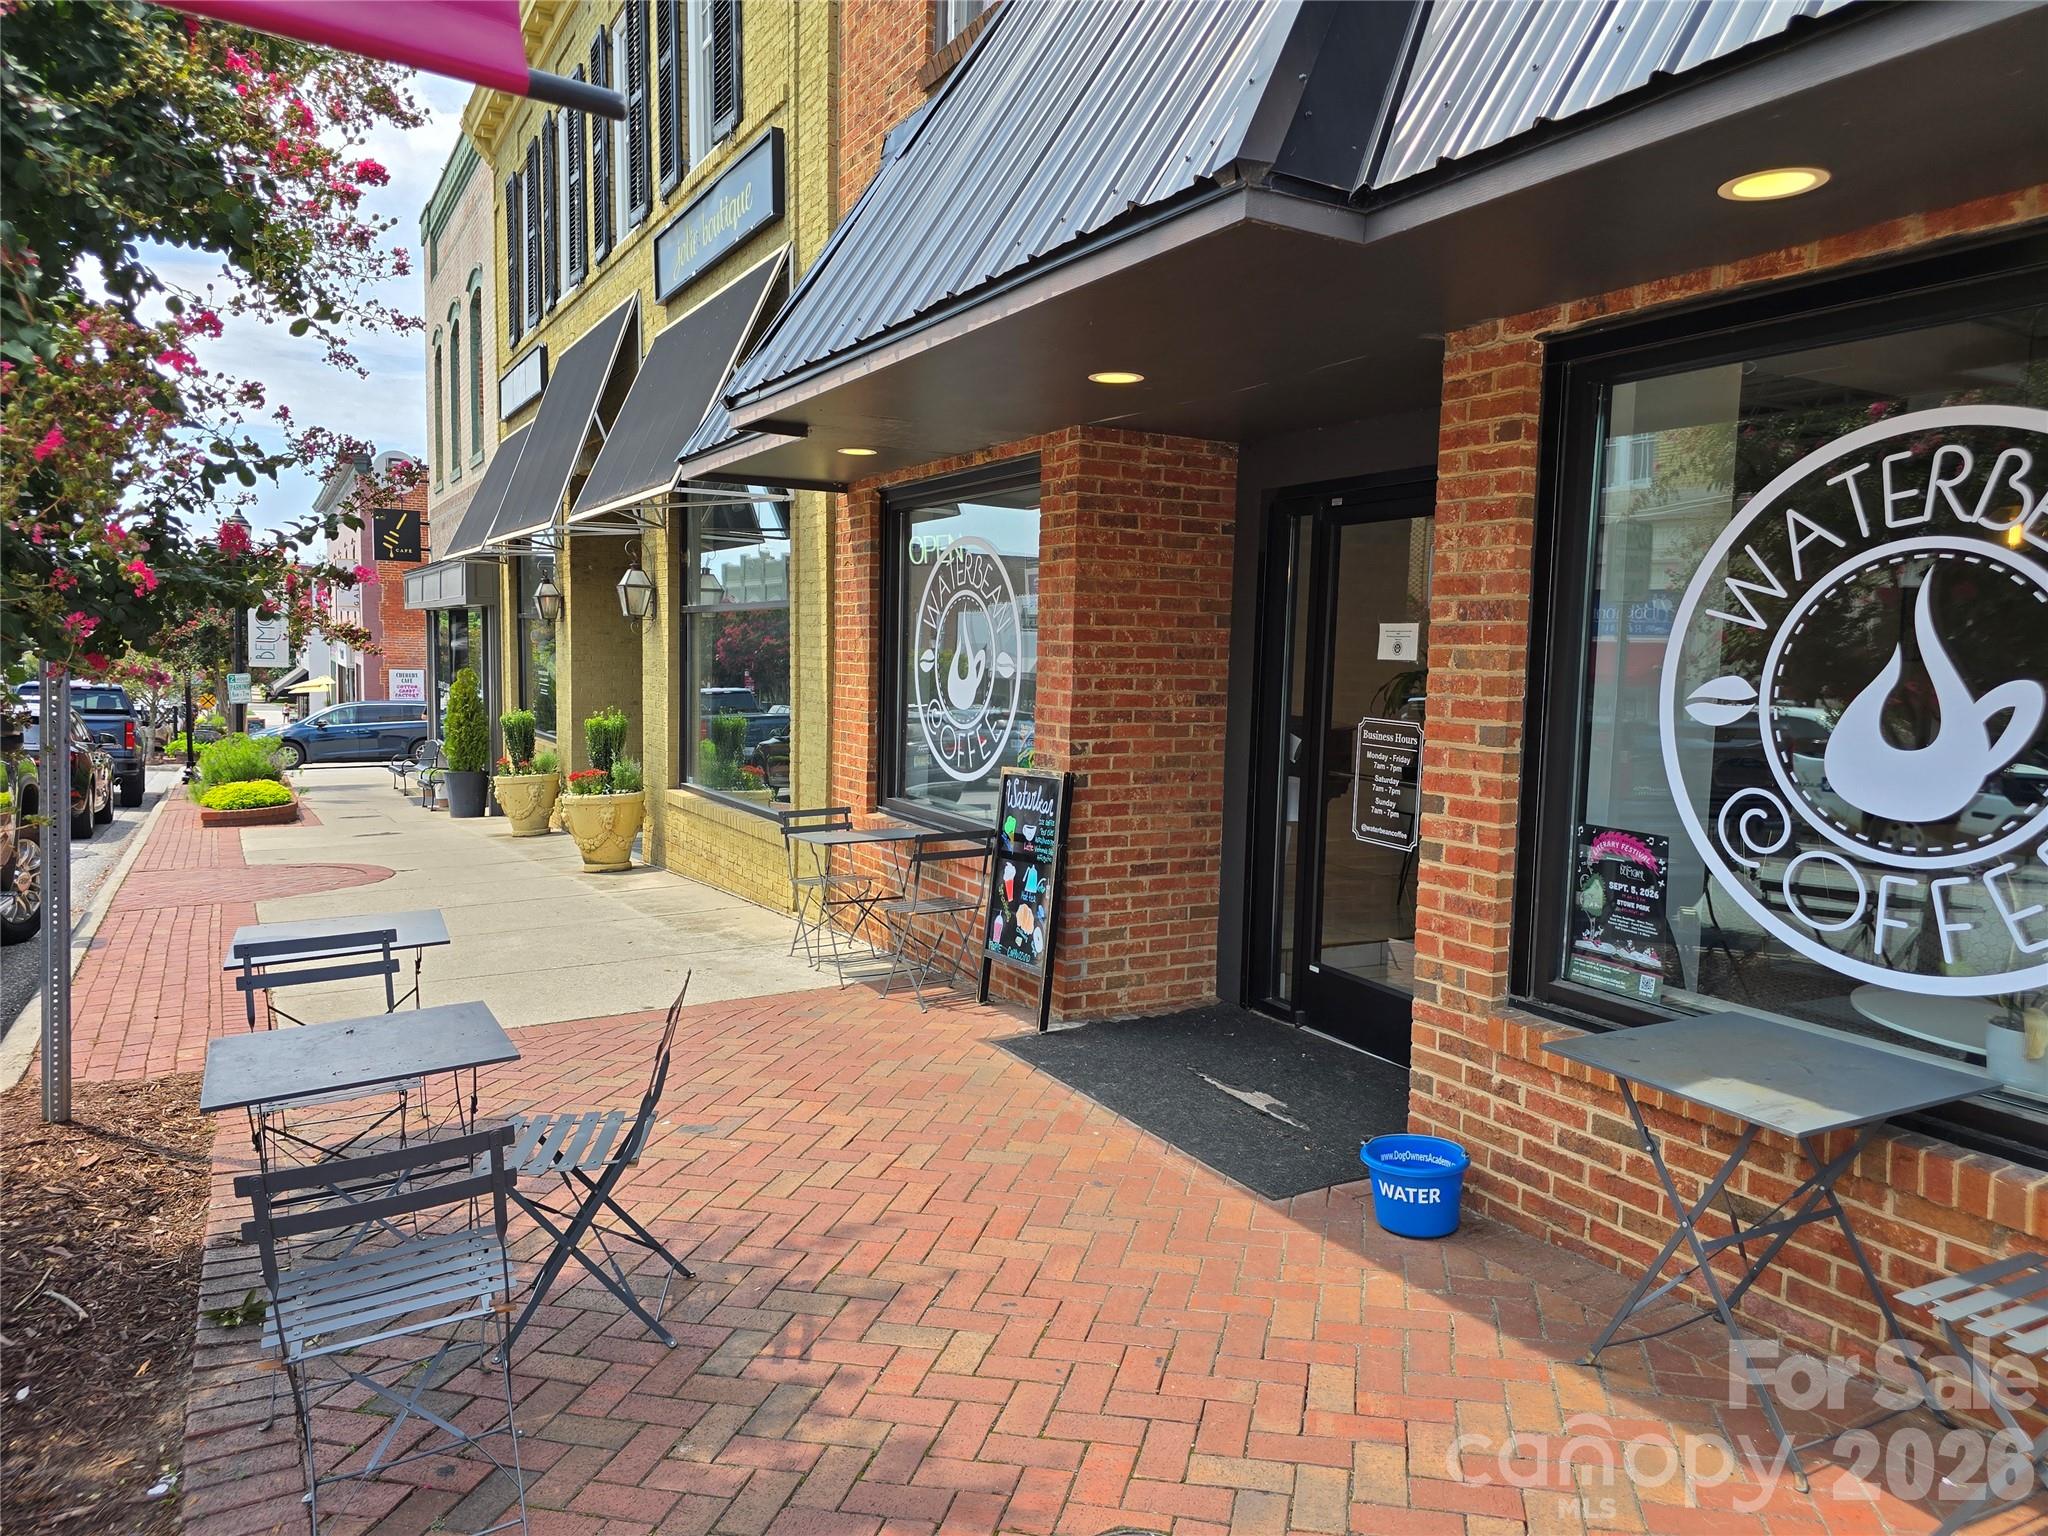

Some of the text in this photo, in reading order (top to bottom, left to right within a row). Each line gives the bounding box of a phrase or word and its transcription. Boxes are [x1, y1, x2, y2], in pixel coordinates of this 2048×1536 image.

[702, 182, 753, 246] boutique
[908, 535, 965, 566] OPEN
[924, 552, 1013, 634] WATERBEAN
[927, 698, 1004, 769] COFFEE
[1363, 729, 1418, 745] Business Hours
[1366, 750, 1389, 762] Monday
[1392, 754, 1411, 766] Friday
[1373, 761, 1386, 770] 7am
[1389, 764, 1402, 774] 7pm
[1372, 783, 1385, 793] 7am
[1388, 786, 1401, 796] 7pm
[1374, 774, 1400, 787] Saturday
[1375, 797, 1397, 809] Sunday
[1370, 806, 1383, 816] 7am
[1387, 809, 1400, 819] 7pm
[1361, 823, 1408, 840] @waterbeancoffee
[1592, 841, 1651, 865] LITERARY FESTIVAL
[1717, 787, 2048, 965] COFFE
[1609, 881, 1660, 900] SEPT. 5, 2026
[1378, 1179, 1441, 1204] WATER
